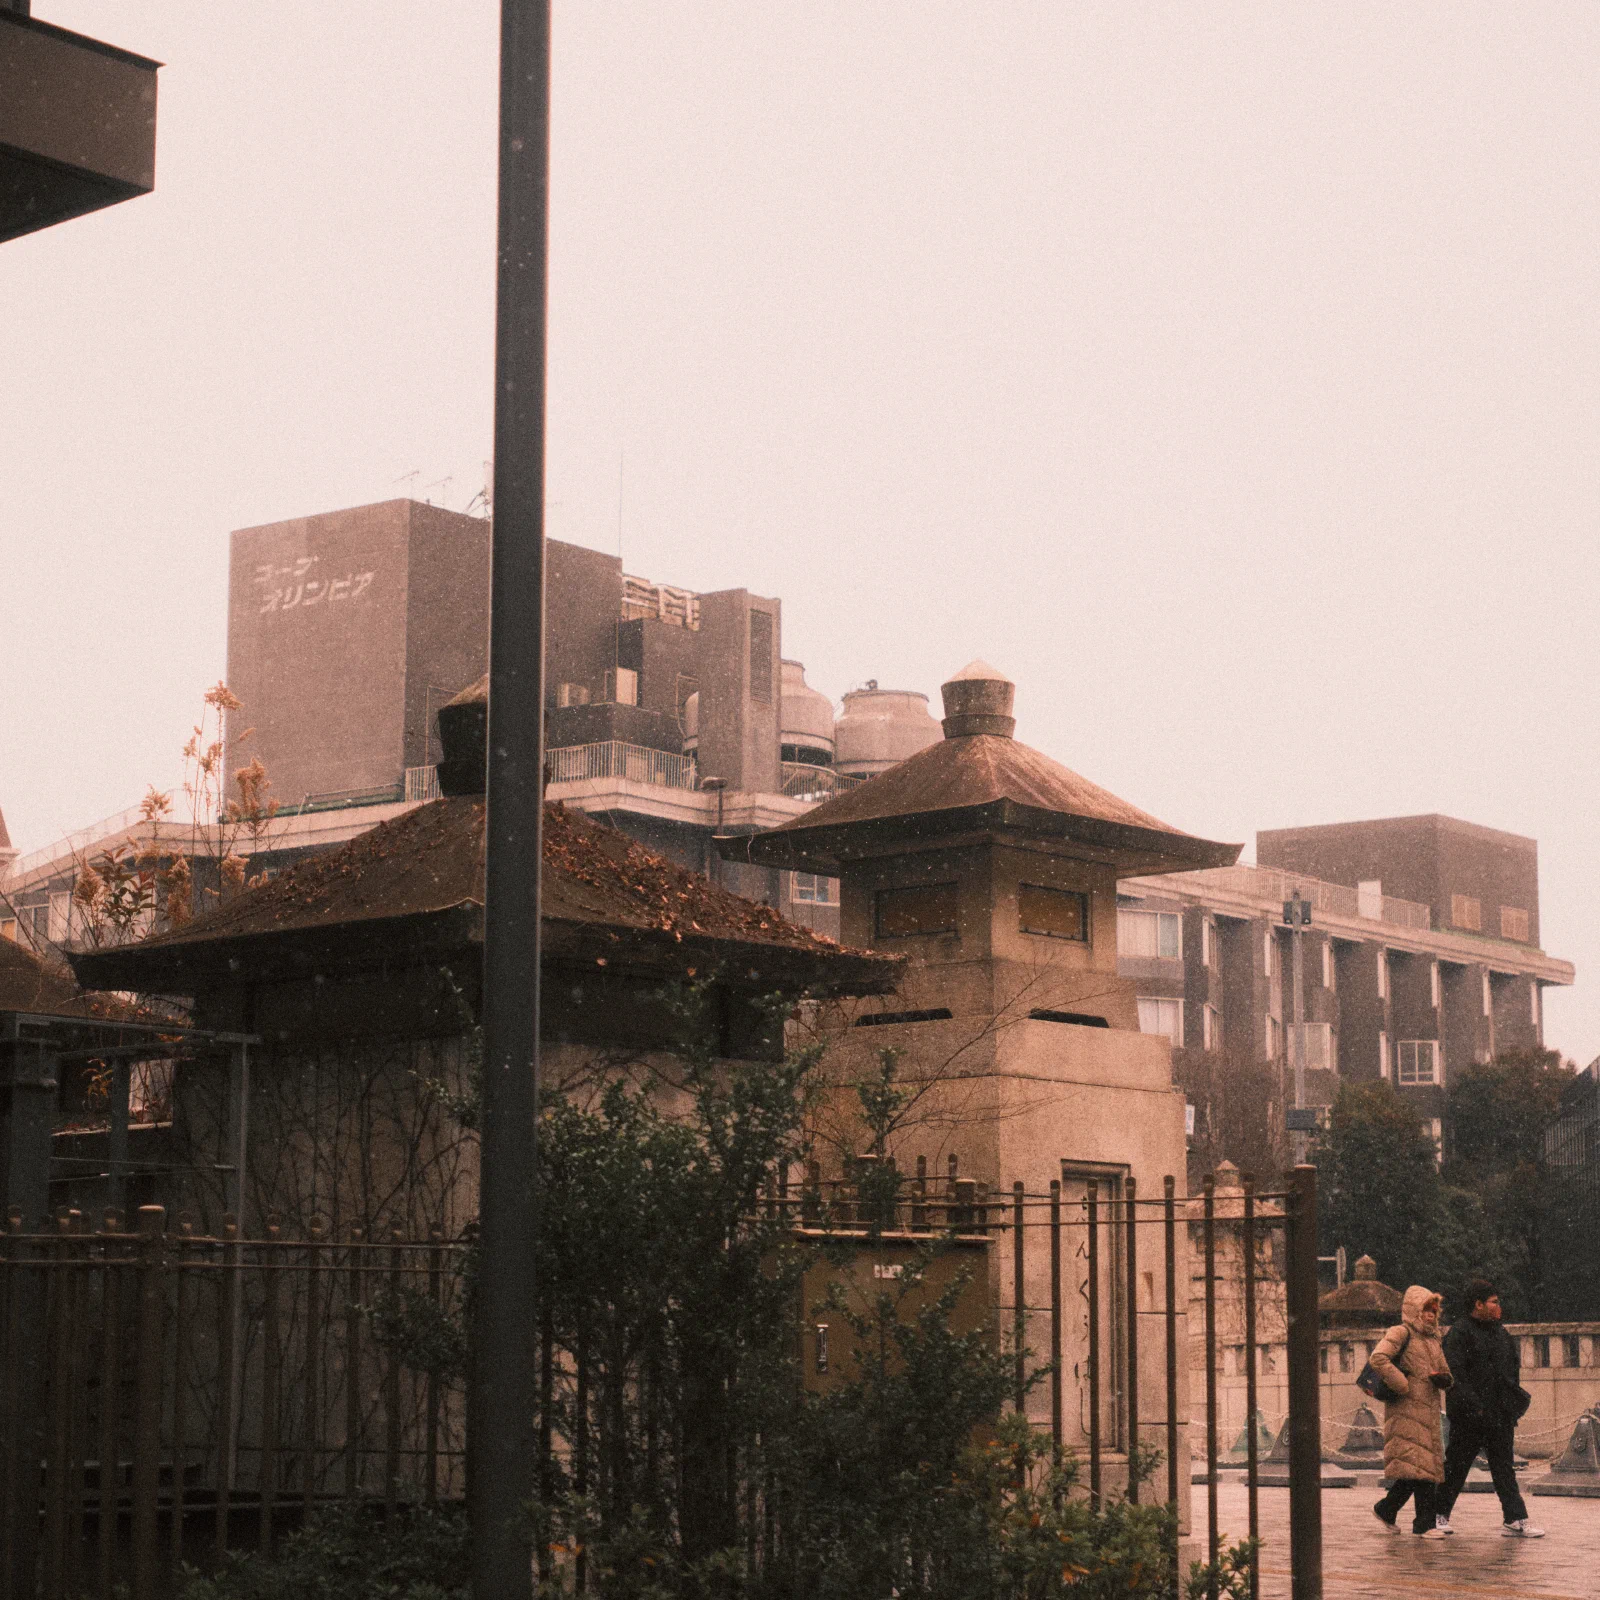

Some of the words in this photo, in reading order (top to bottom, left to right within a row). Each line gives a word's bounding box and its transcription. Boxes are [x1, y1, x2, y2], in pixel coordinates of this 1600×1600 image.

[254, 555, 318, 583] コープ
[260, 571, 375, 613] オリンピア
